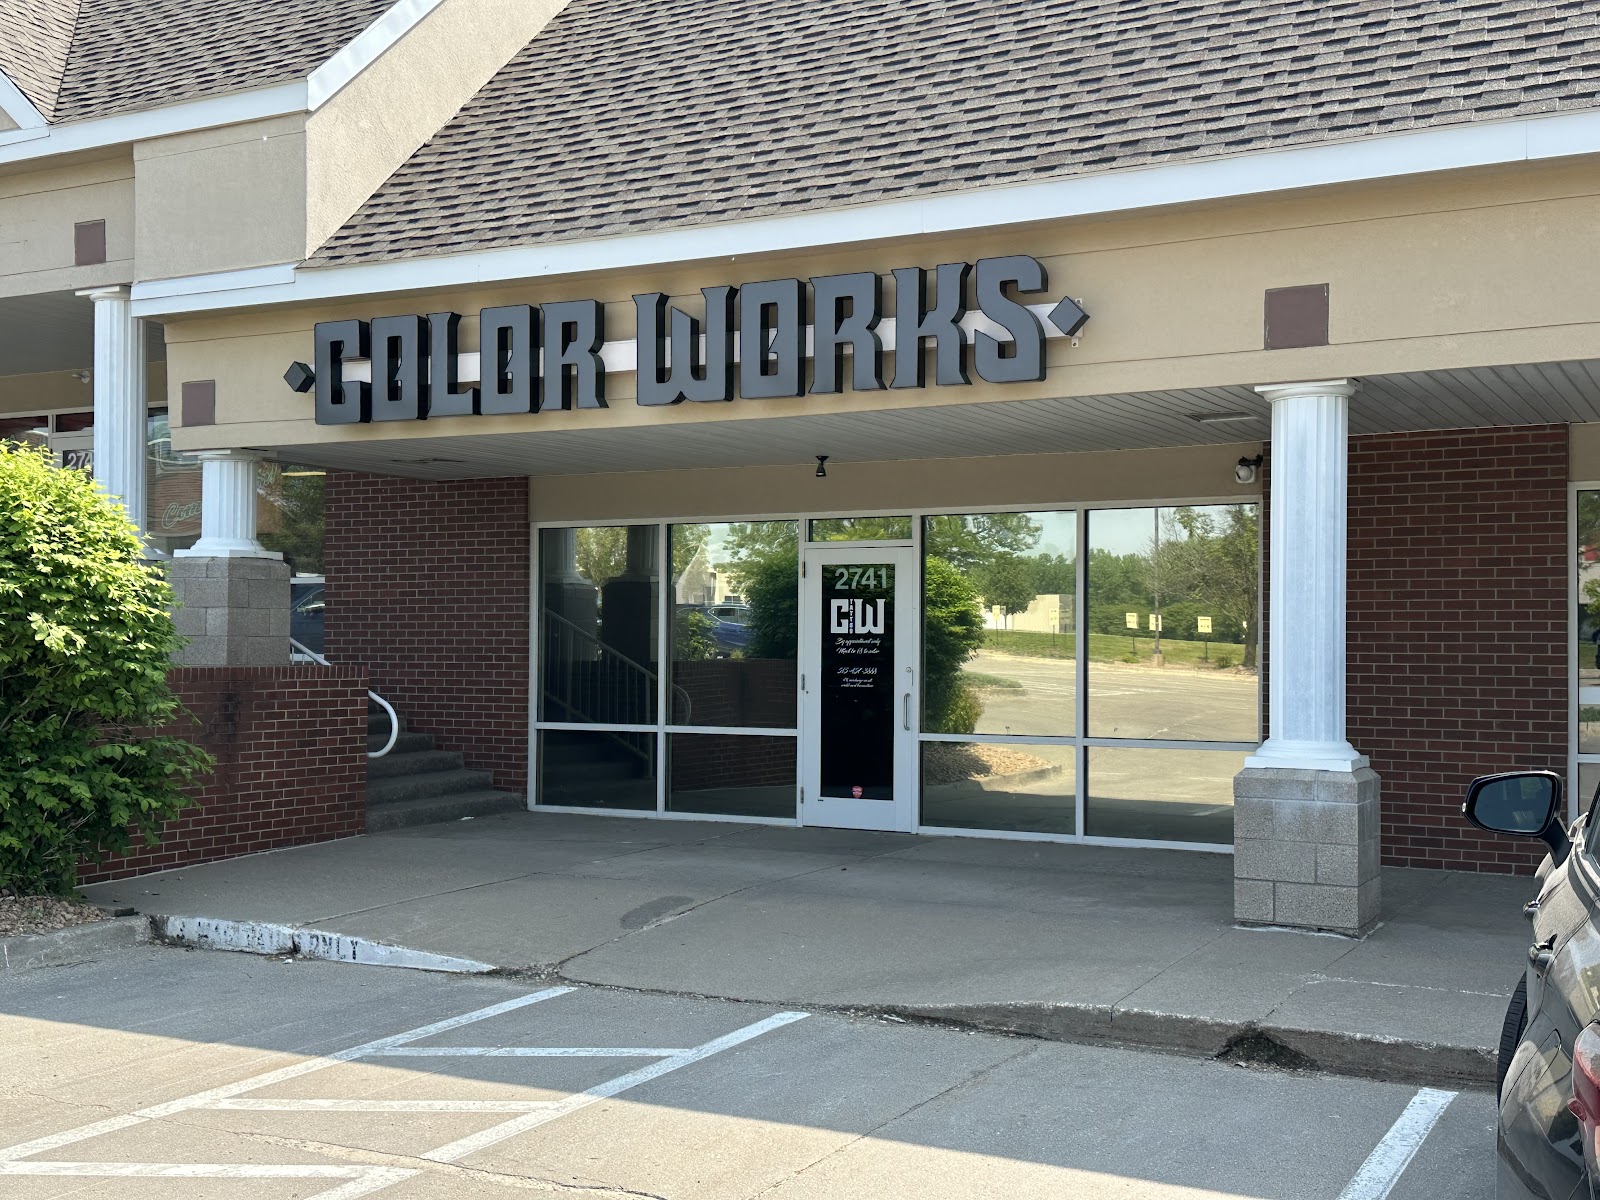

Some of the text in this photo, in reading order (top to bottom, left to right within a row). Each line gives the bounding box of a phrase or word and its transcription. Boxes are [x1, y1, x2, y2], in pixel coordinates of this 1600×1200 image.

[314, 254, 1048, 425] COLOR WORKS
[835, 567, 887, 590] 2741
